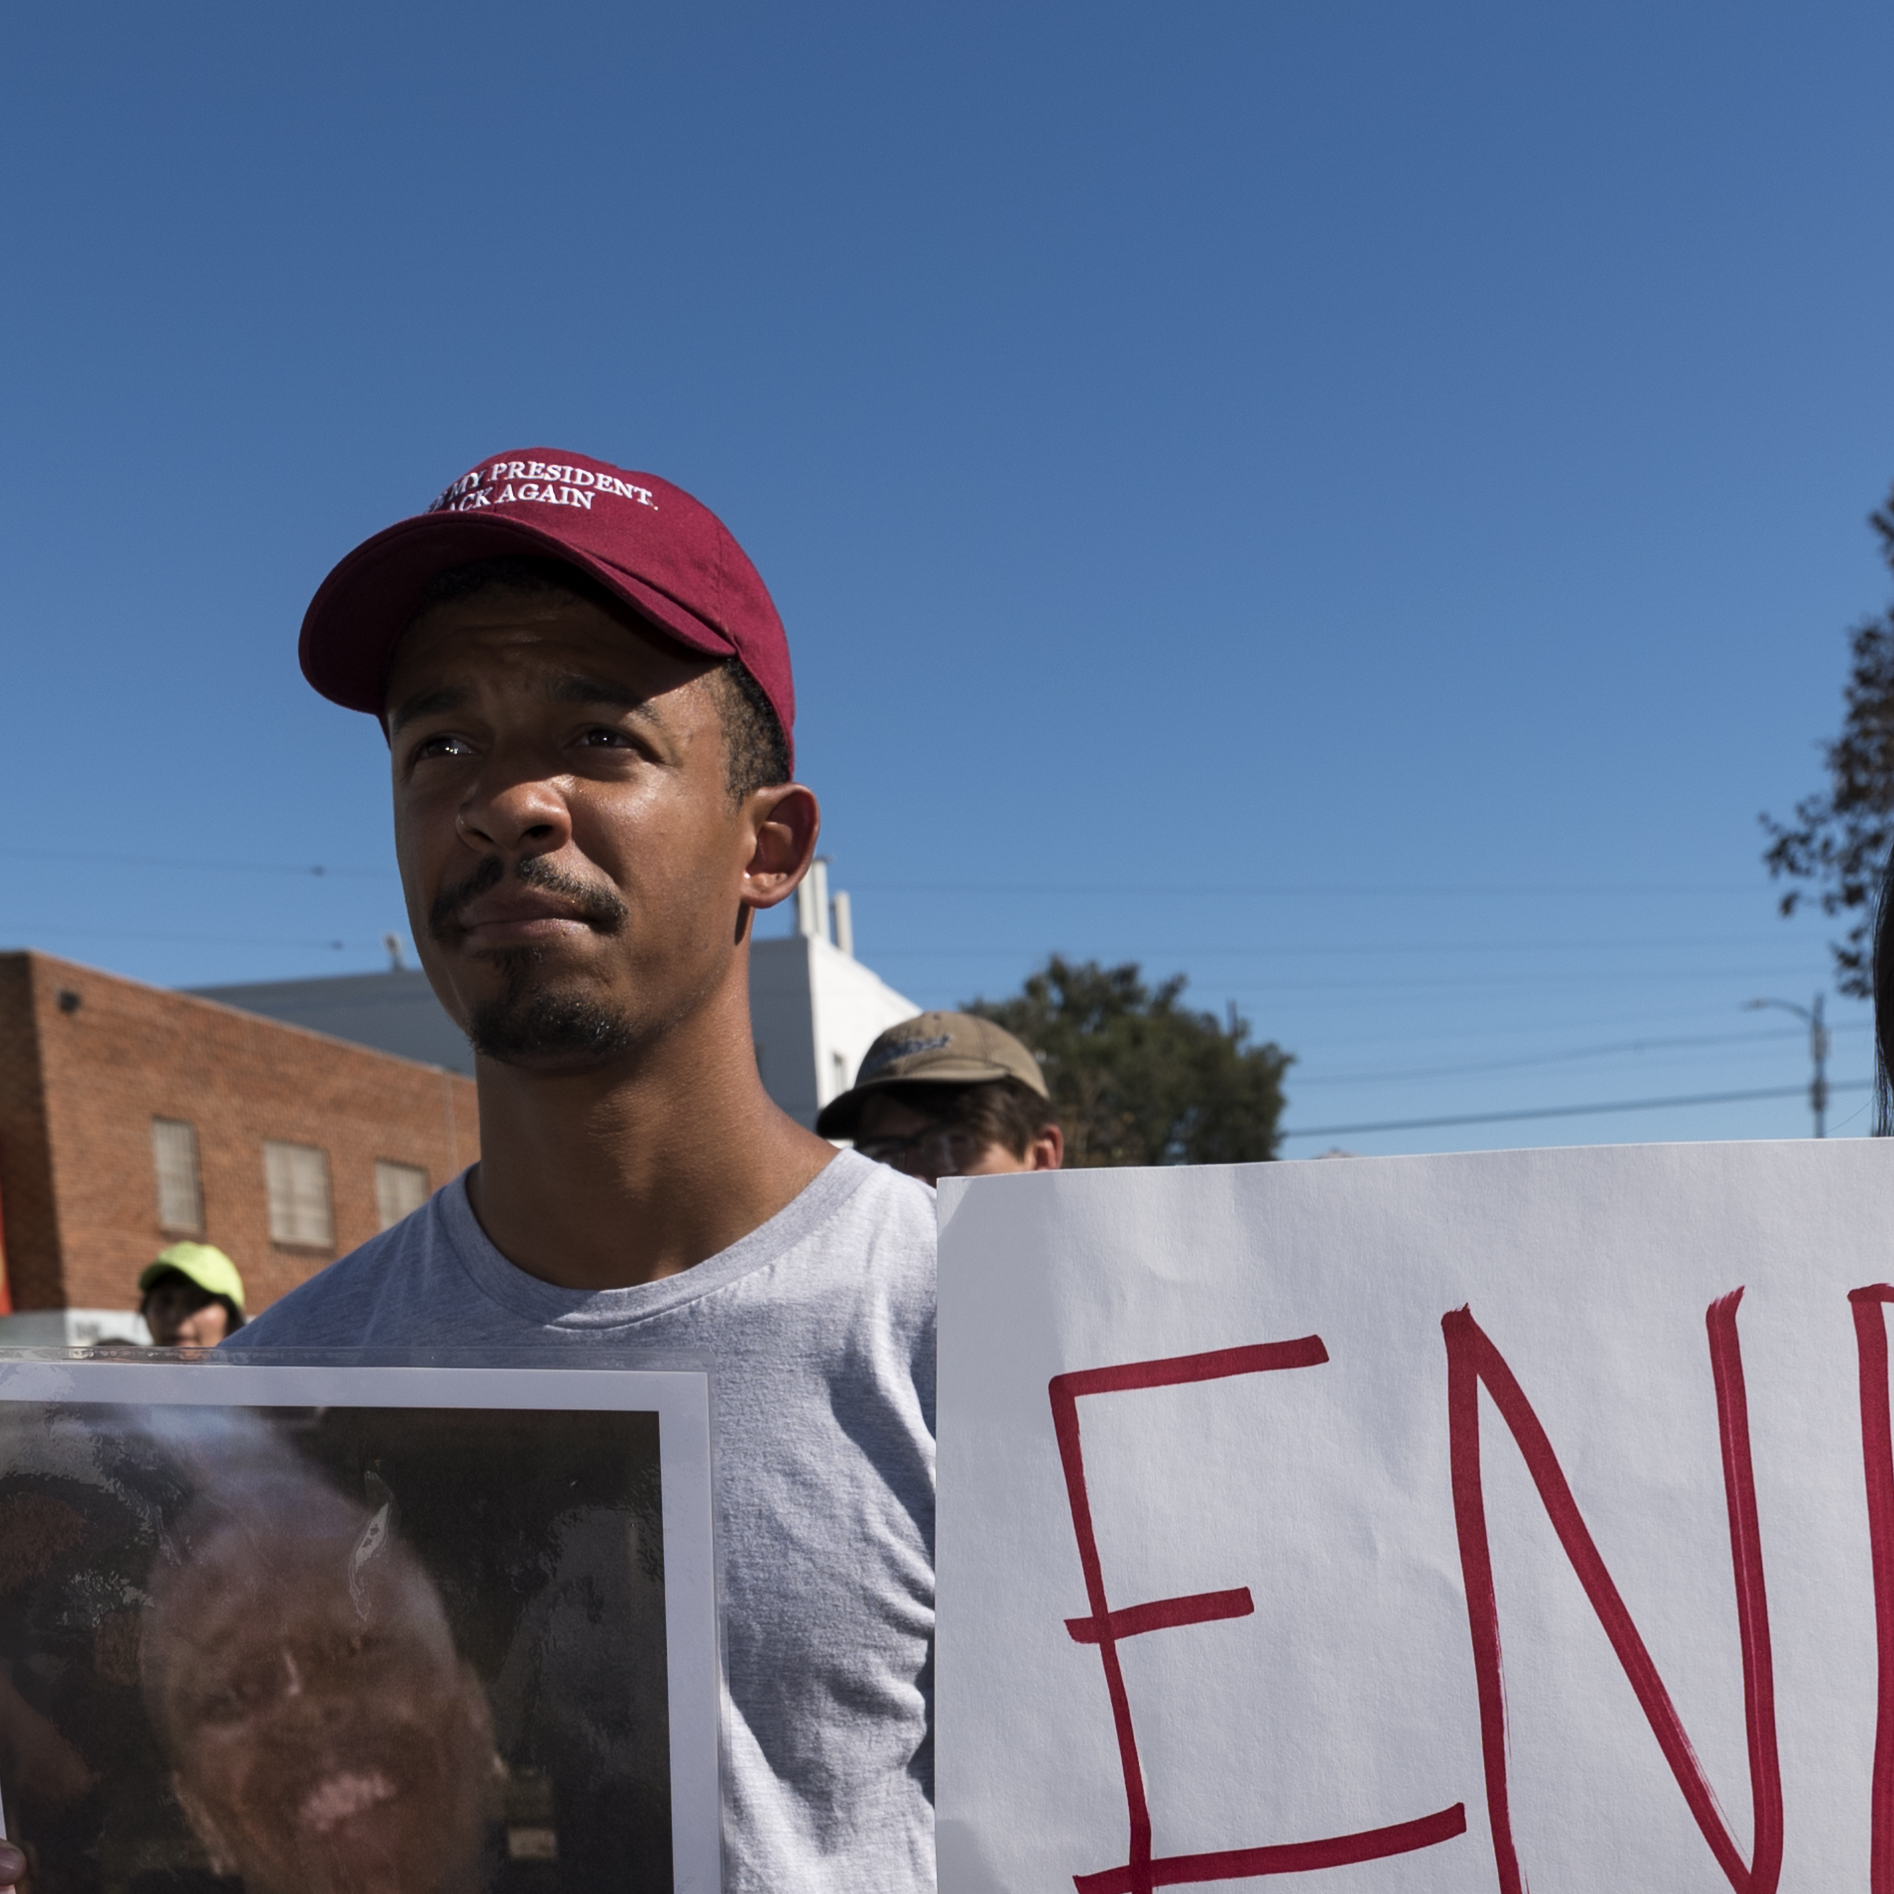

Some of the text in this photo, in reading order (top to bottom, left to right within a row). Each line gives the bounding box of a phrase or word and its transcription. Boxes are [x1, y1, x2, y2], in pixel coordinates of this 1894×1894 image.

[447, 467, 487, 502] MY
[487, 460, 654, 506] PRESIDENT
[494, 483, 596, 509] AGAIN
